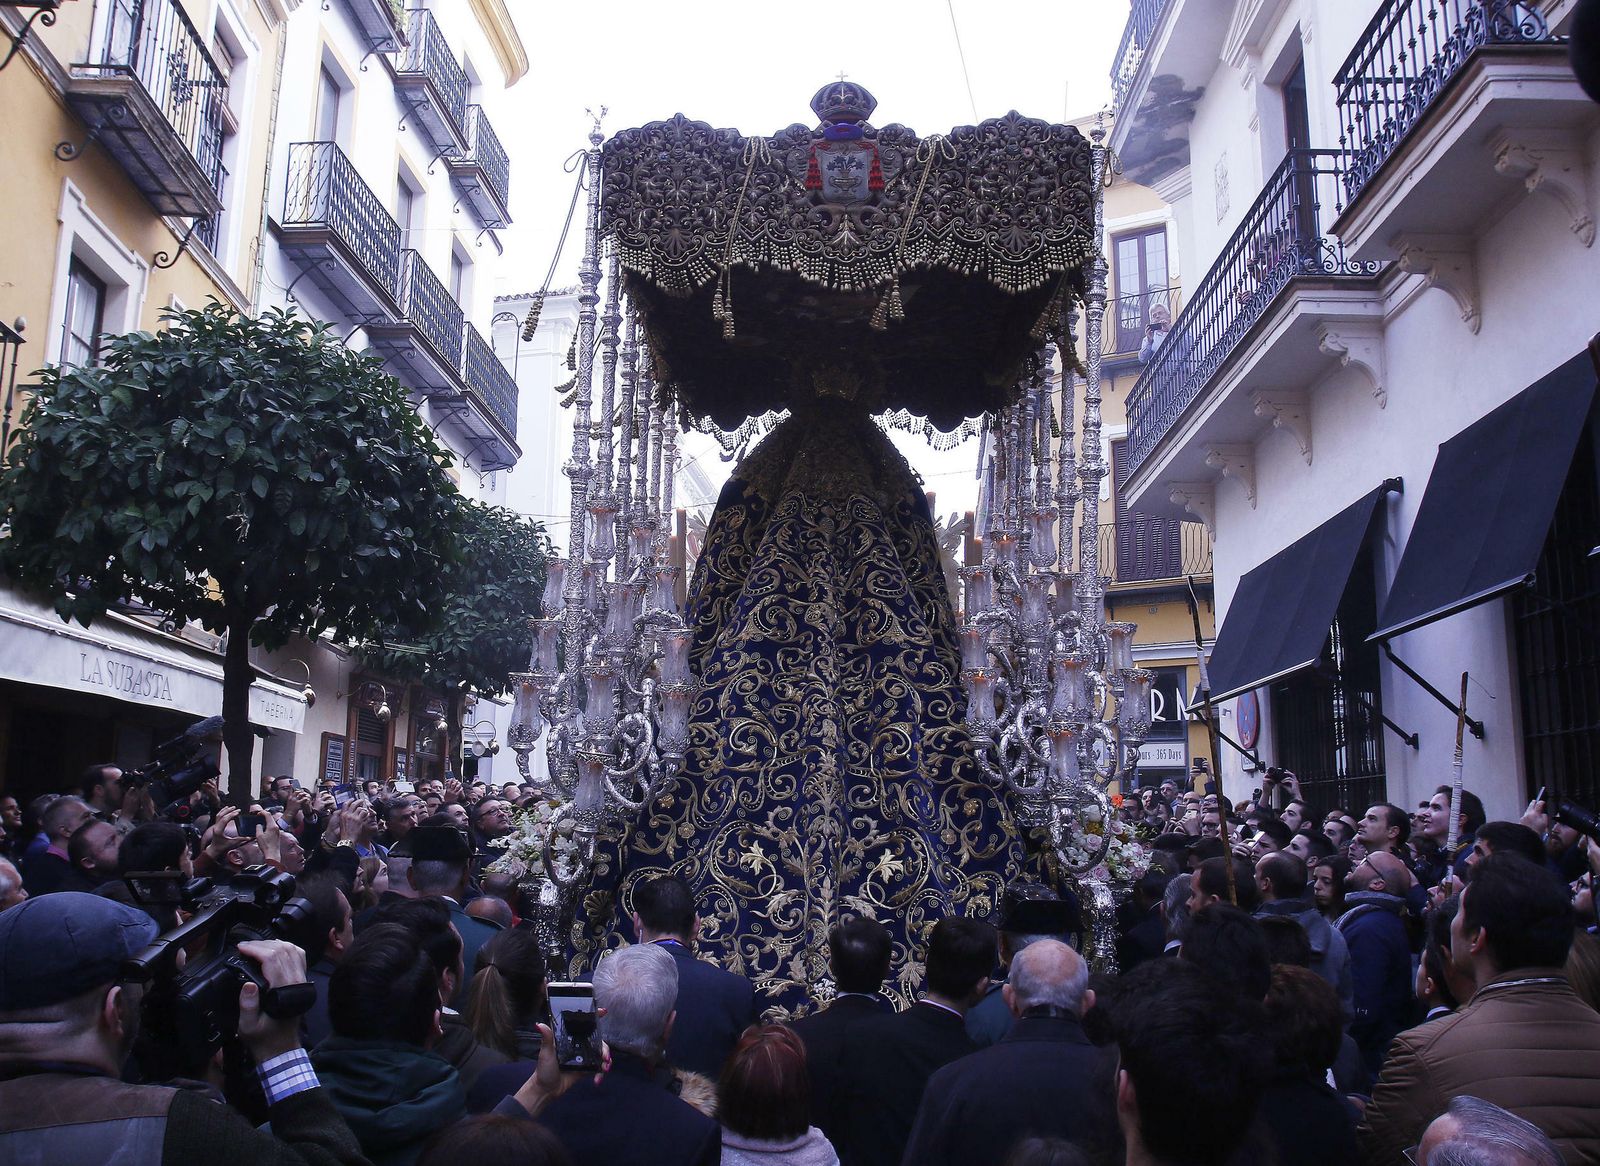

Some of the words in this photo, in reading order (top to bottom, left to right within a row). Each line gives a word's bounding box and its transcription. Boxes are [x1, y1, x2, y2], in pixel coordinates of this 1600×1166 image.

[80, 653, 103, 684] LA
[107, 660, 173, 701] SUBASTA
[261, 700, 294, 720] TABERNA
[1156, 749, 1167, 759] 365
[1168, 748, 1182, 761] Days
